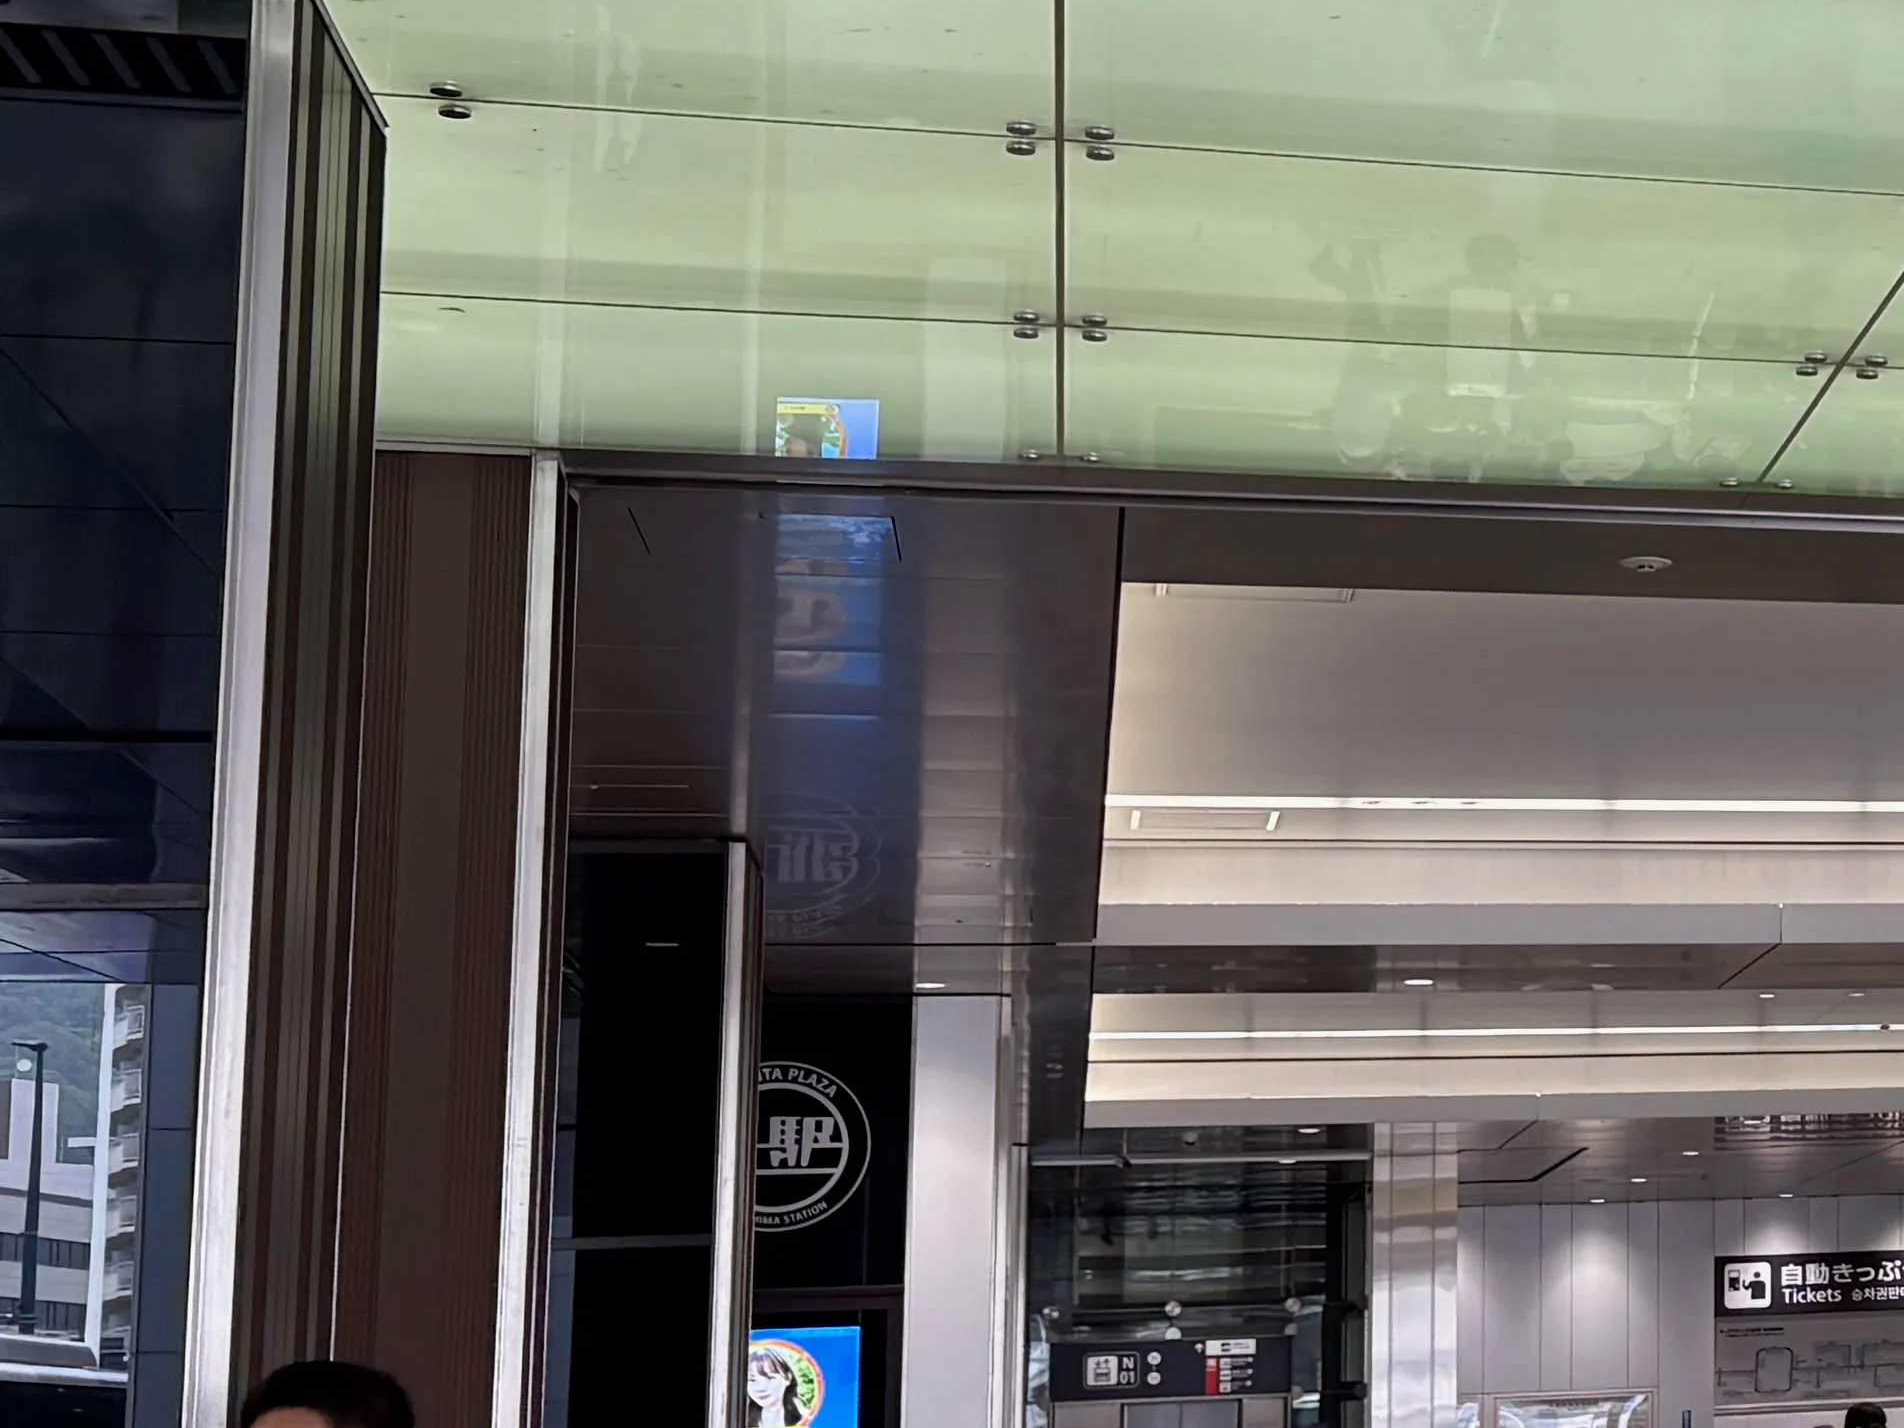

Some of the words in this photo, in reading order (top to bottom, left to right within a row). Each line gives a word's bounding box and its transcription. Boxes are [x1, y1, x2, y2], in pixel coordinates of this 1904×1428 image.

[788, 1068, 838, 1098] PLAZA
[783, 1200, 828, 1225] STATION
[1782, 1288, 1842, 1304] Tickets
[1121, 1356, 1135, 1369] N
[1120, 1372, 1135, 1384] 01
